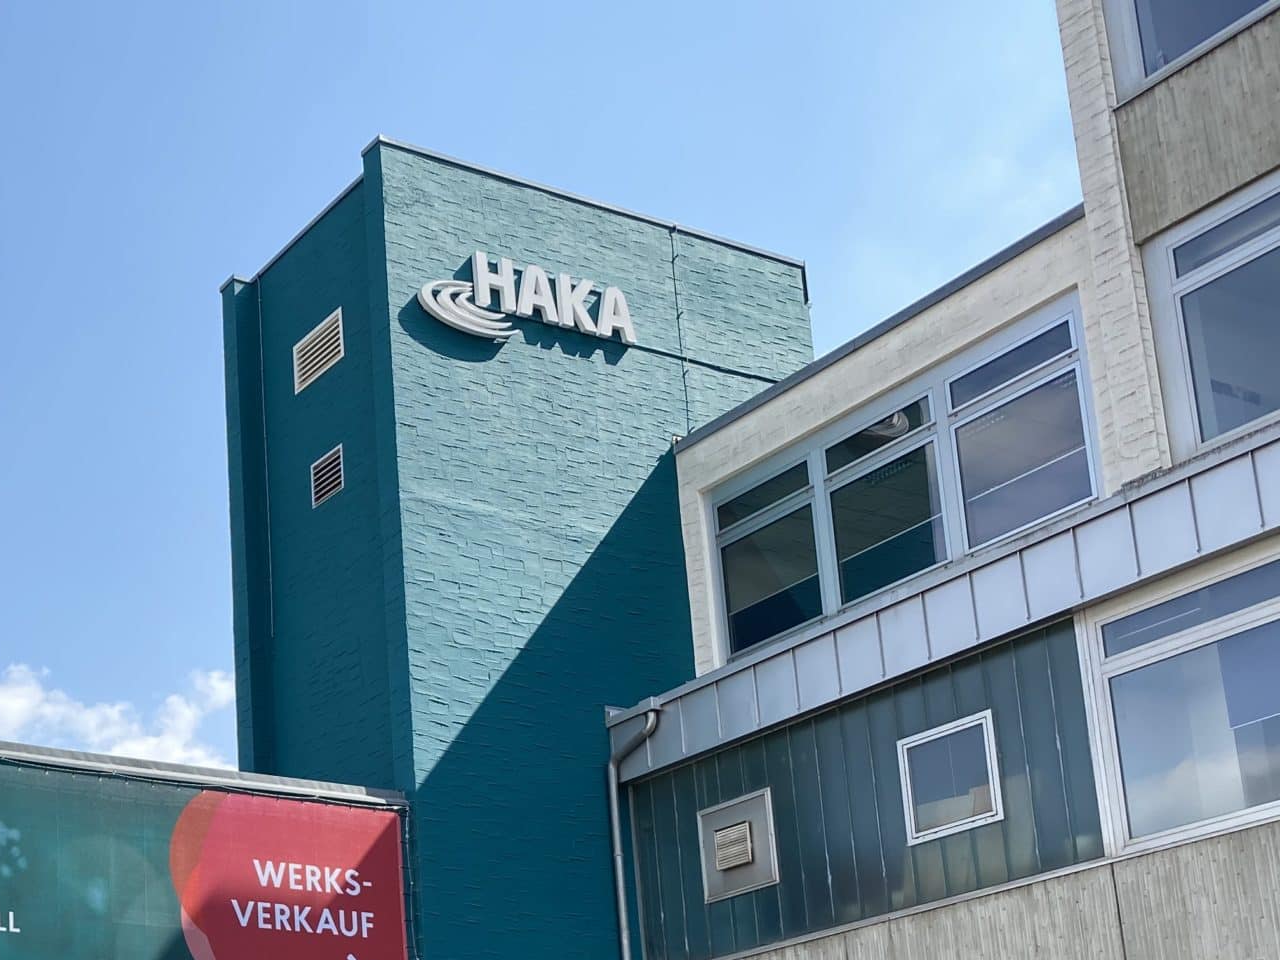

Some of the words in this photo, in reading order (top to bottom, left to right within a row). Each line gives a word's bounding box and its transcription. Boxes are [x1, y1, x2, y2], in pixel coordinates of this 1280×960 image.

[472, 250, 636, 345] HAKA
[252, 858, 373, 897] WERKS-
[230, 898, 375, 939] VERKAUF
